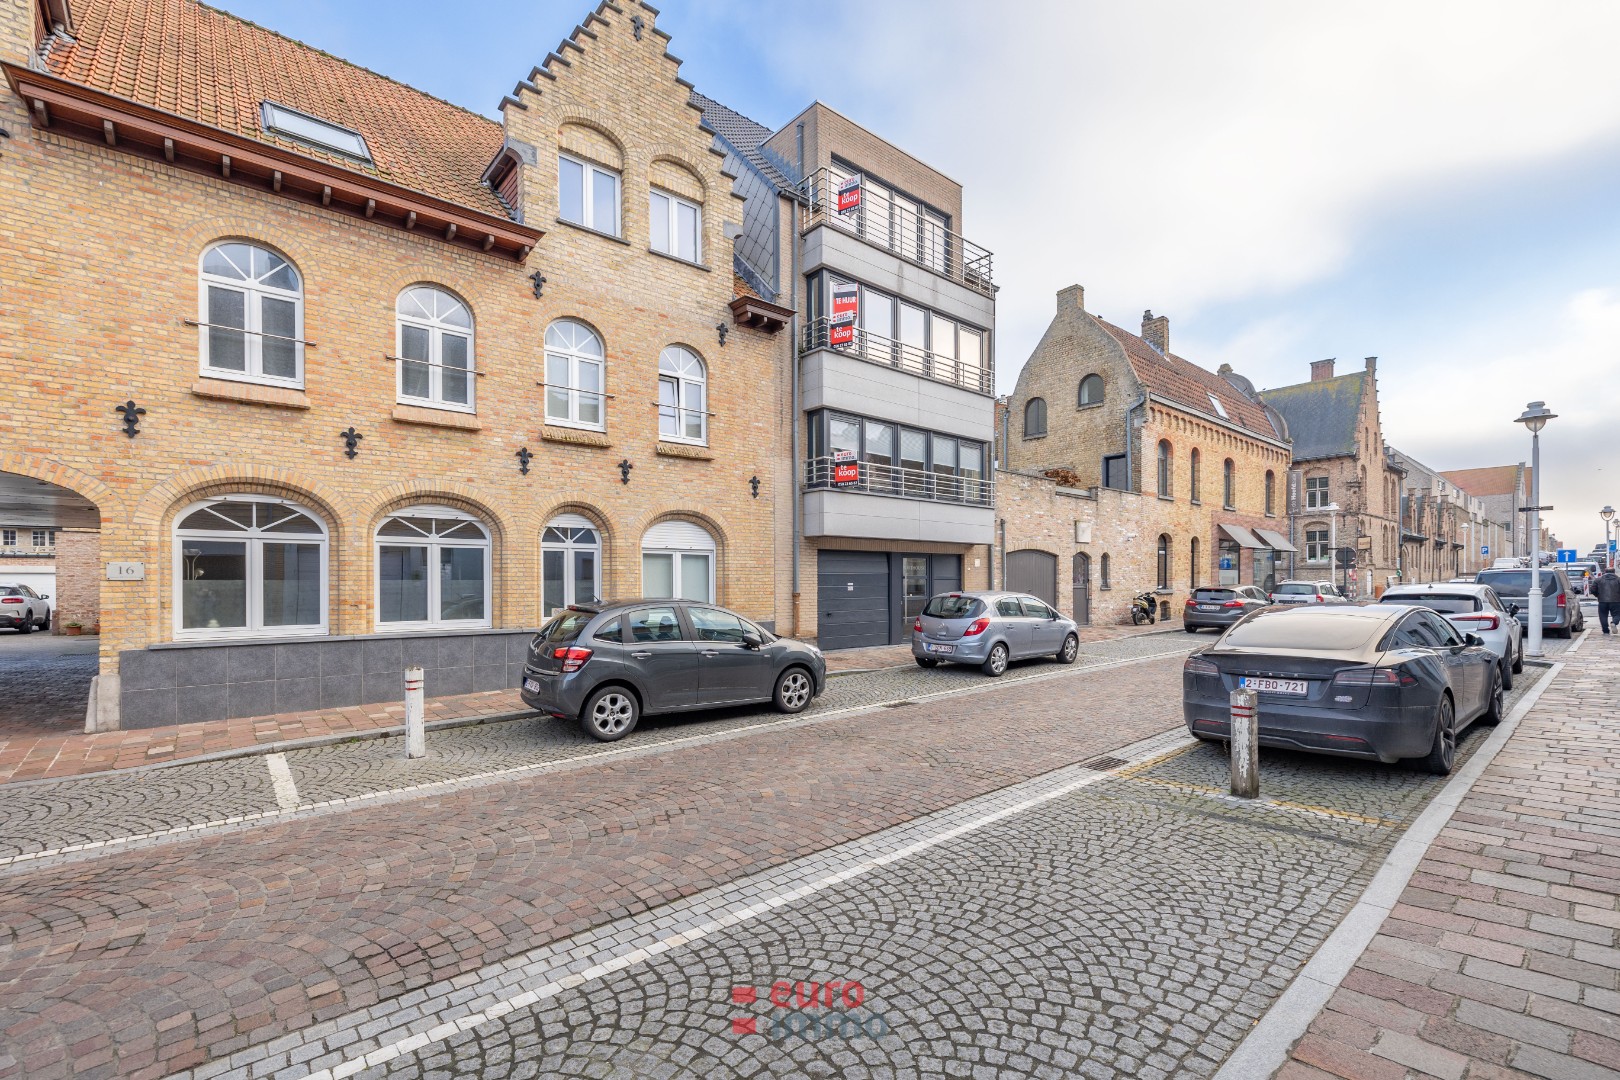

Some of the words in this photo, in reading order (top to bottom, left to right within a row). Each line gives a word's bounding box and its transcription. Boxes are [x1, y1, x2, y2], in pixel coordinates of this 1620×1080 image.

[841, 193, 859, 205] koop
[836, 297, 842, 305] TE
[842, 296, 857, 304] HUUR
[834, 329, 851, 339] koop
[838, 469, 856, 478] koop
[118, 566, 135, 575] 16
